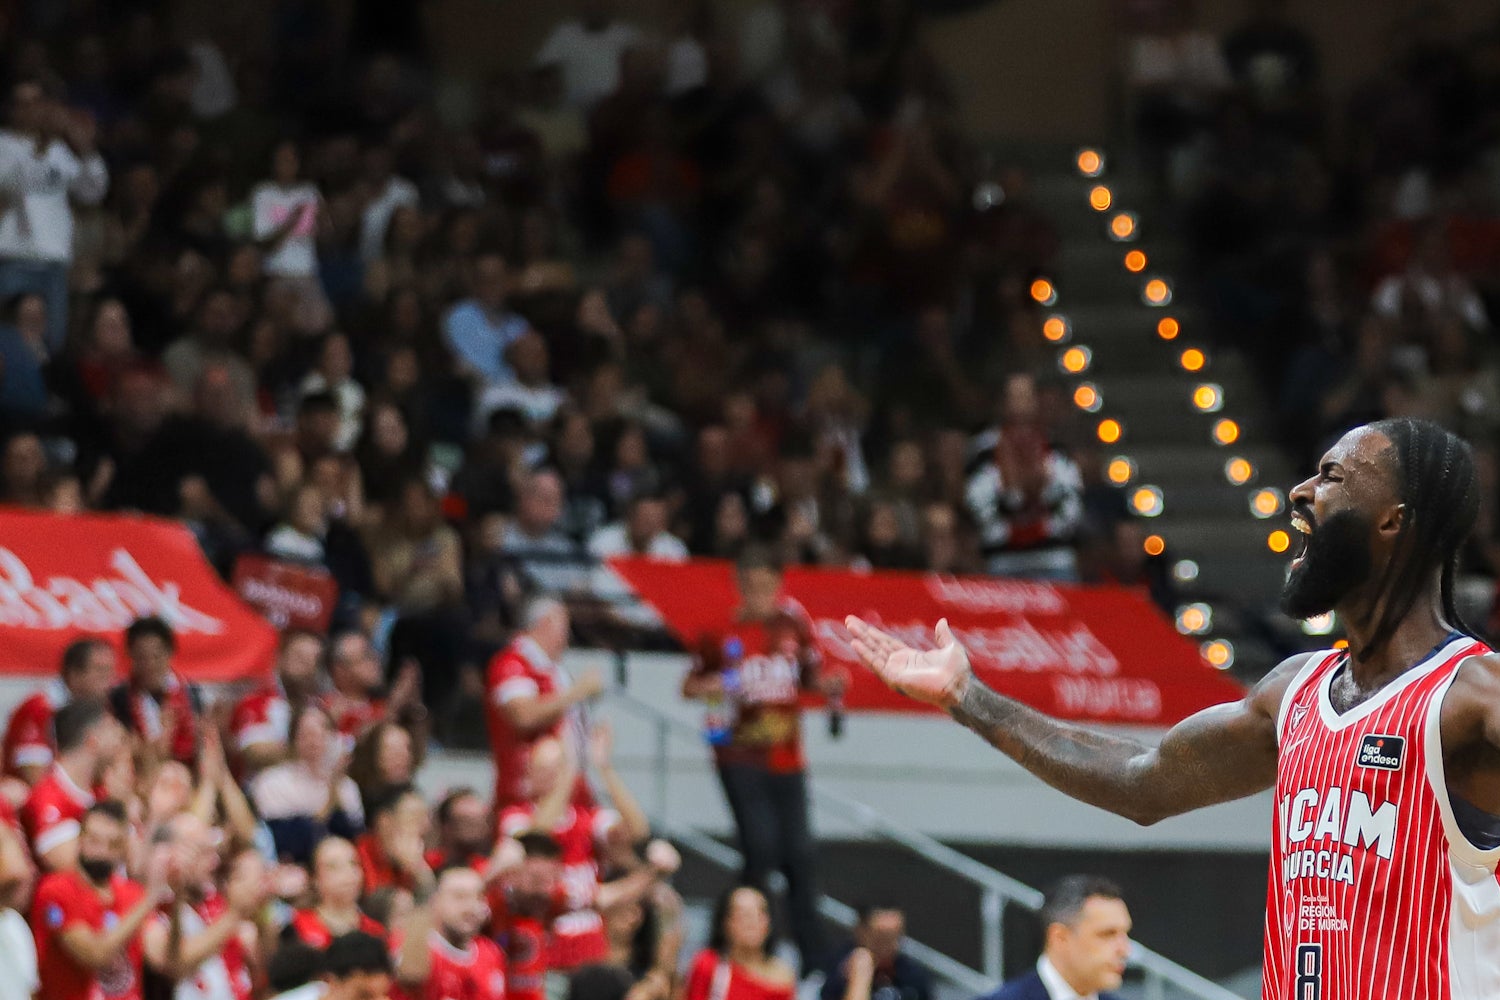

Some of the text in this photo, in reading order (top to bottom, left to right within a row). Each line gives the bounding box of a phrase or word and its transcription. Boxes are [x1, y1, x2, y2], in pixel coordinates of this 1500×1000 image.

[1364, 744, 1380, 755] liga
[1361, 754, 1398, 766] endesa
[1301, 919, 1348, 931] DE MURCIA
